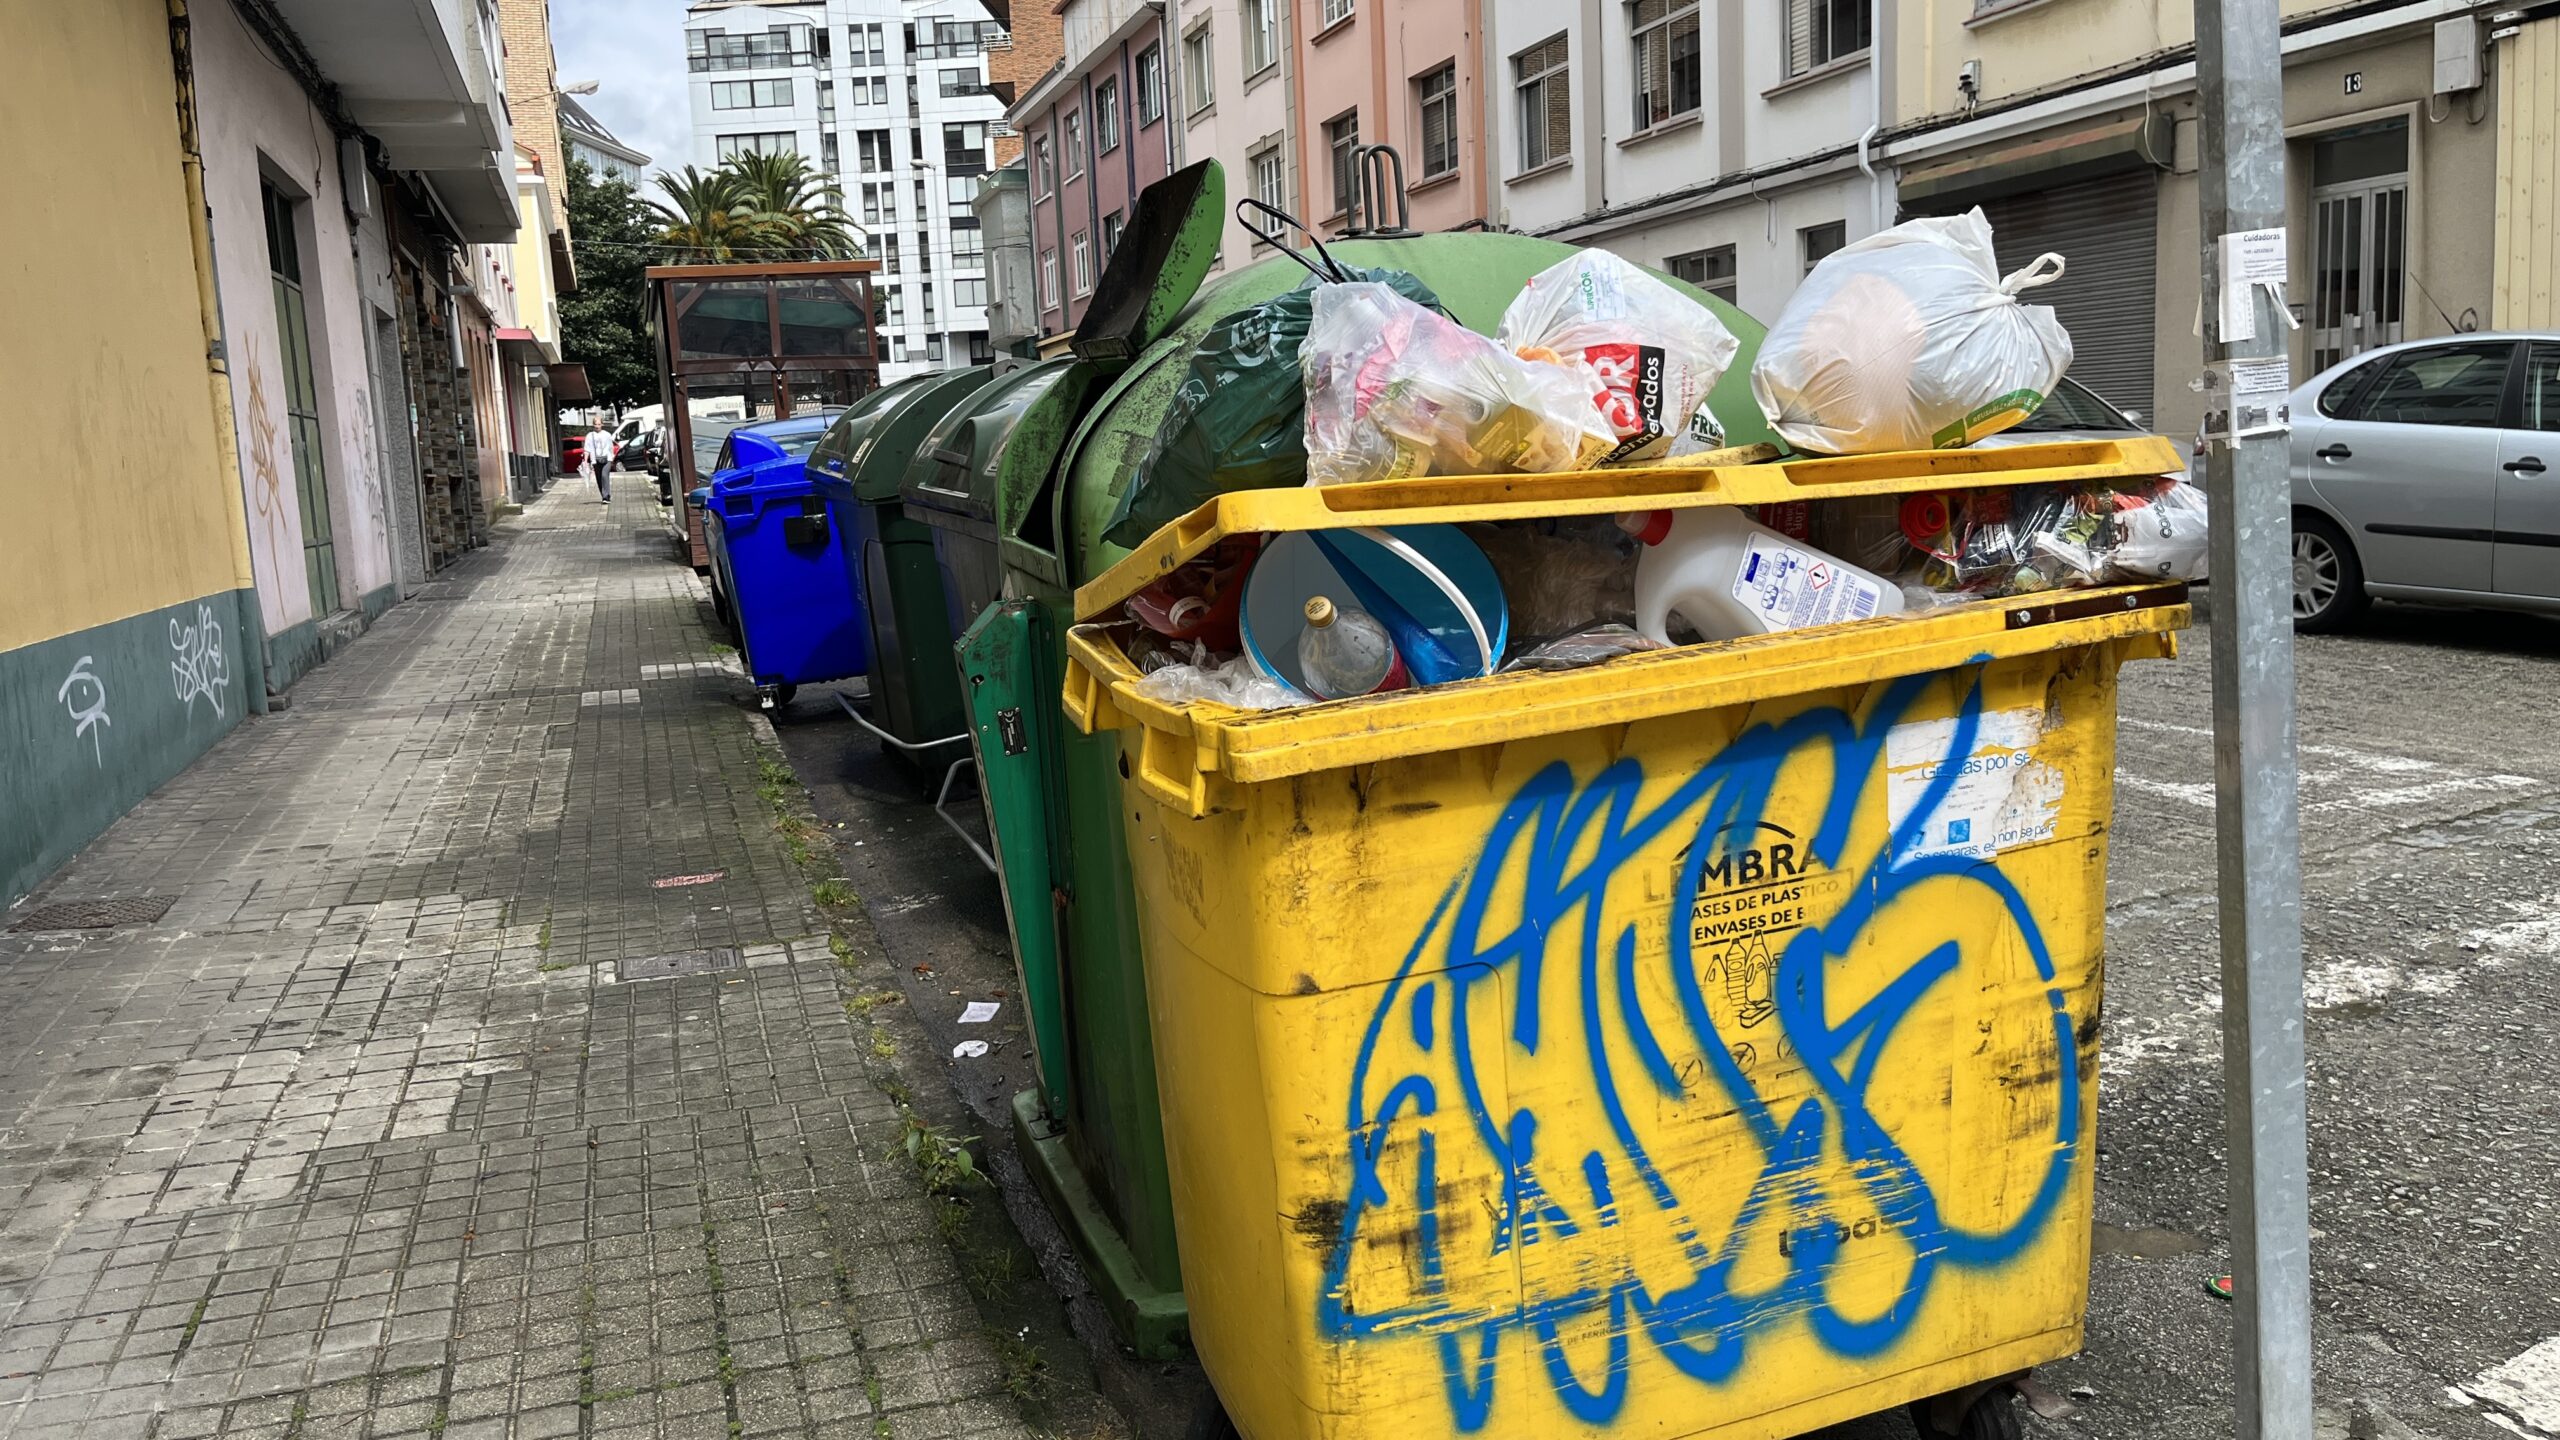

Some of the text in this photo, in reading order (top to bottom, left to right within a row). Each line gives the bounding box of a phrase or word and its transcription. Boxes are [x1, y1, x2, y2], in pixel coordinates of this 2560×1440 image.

[2346, 74, 2361, 93] 13
[2244, 234, 2280, 242] Cuidadoras
[1736, 898, 1757, 911] DE
[1694, 912, 1766, 941] ENVASES
[1771, 911, 1792, 926] DE
